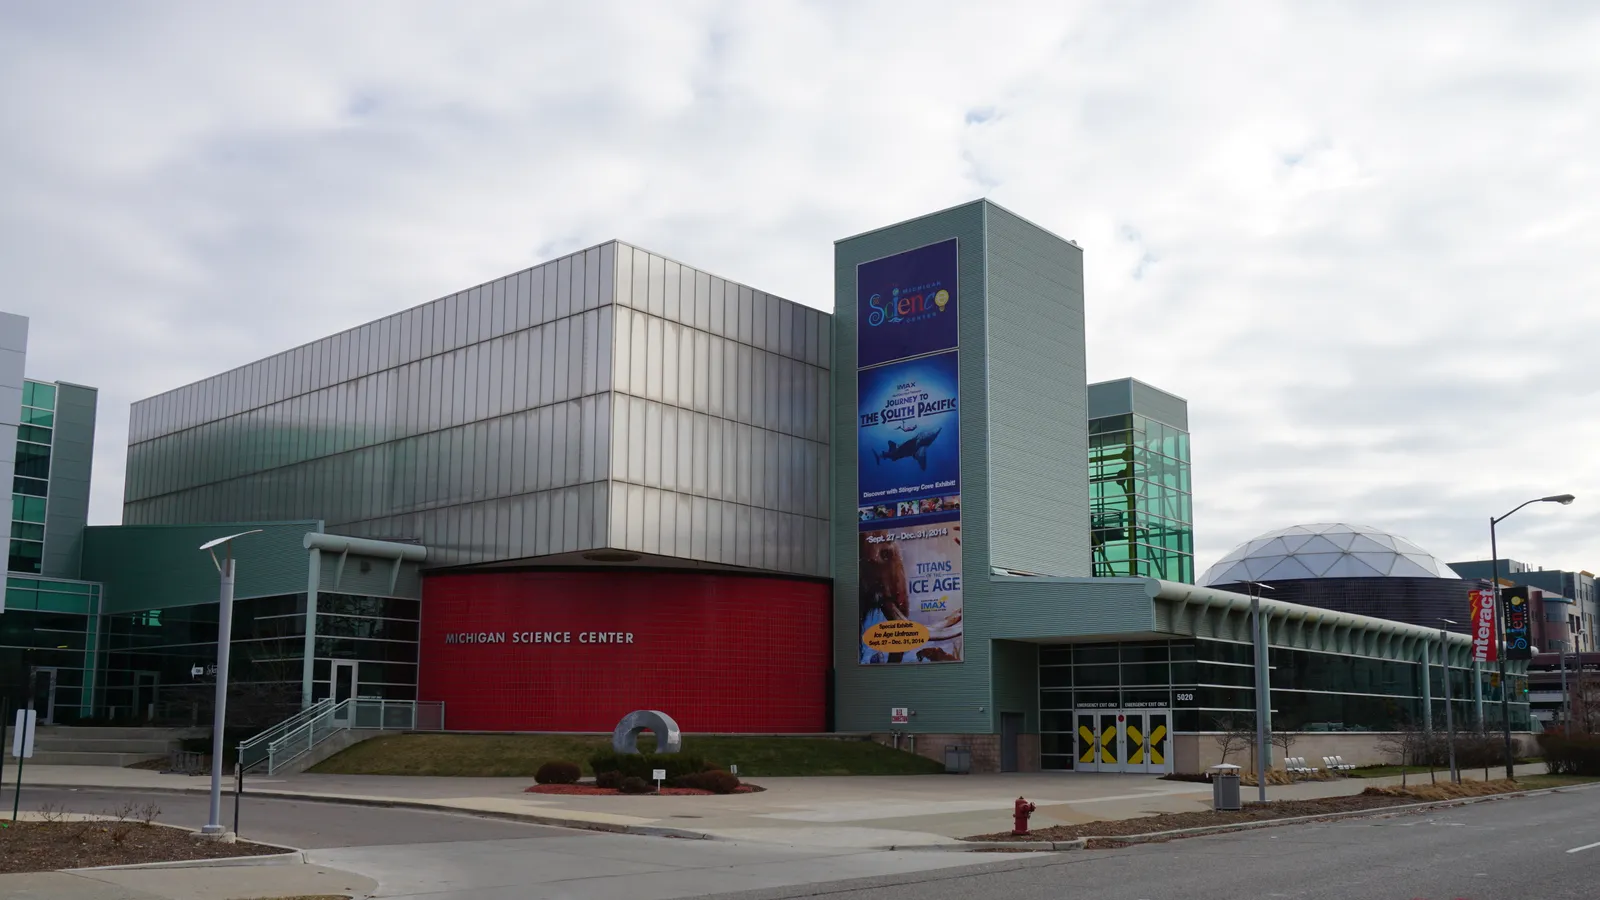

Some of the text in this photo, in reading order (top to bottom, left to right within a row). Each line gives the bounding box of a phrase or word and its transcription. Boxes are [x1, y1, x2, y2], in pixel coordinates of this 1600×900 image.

[897, 382, 915, 390] IMAX
[885, 395, 918, 408] JOURNEY
[860, 398, 957, 425] THE SOUTH PACIFIC
[863, 490, 886, 498] Discover
[898, 486, 920, 494] Stingray
[935, 480, 956, 488] Exhibit!
[868, 535, 885, 543] Sept.
[917, 531, 928, 539] 31,
[929, 527, 948, 536] 2014
[917, 560, 952, 574] TITANS
[909, 577, 960, 594] ICE AGE
[445, 631, 634, 644] MICHIGAN SCIENCE CENTER
